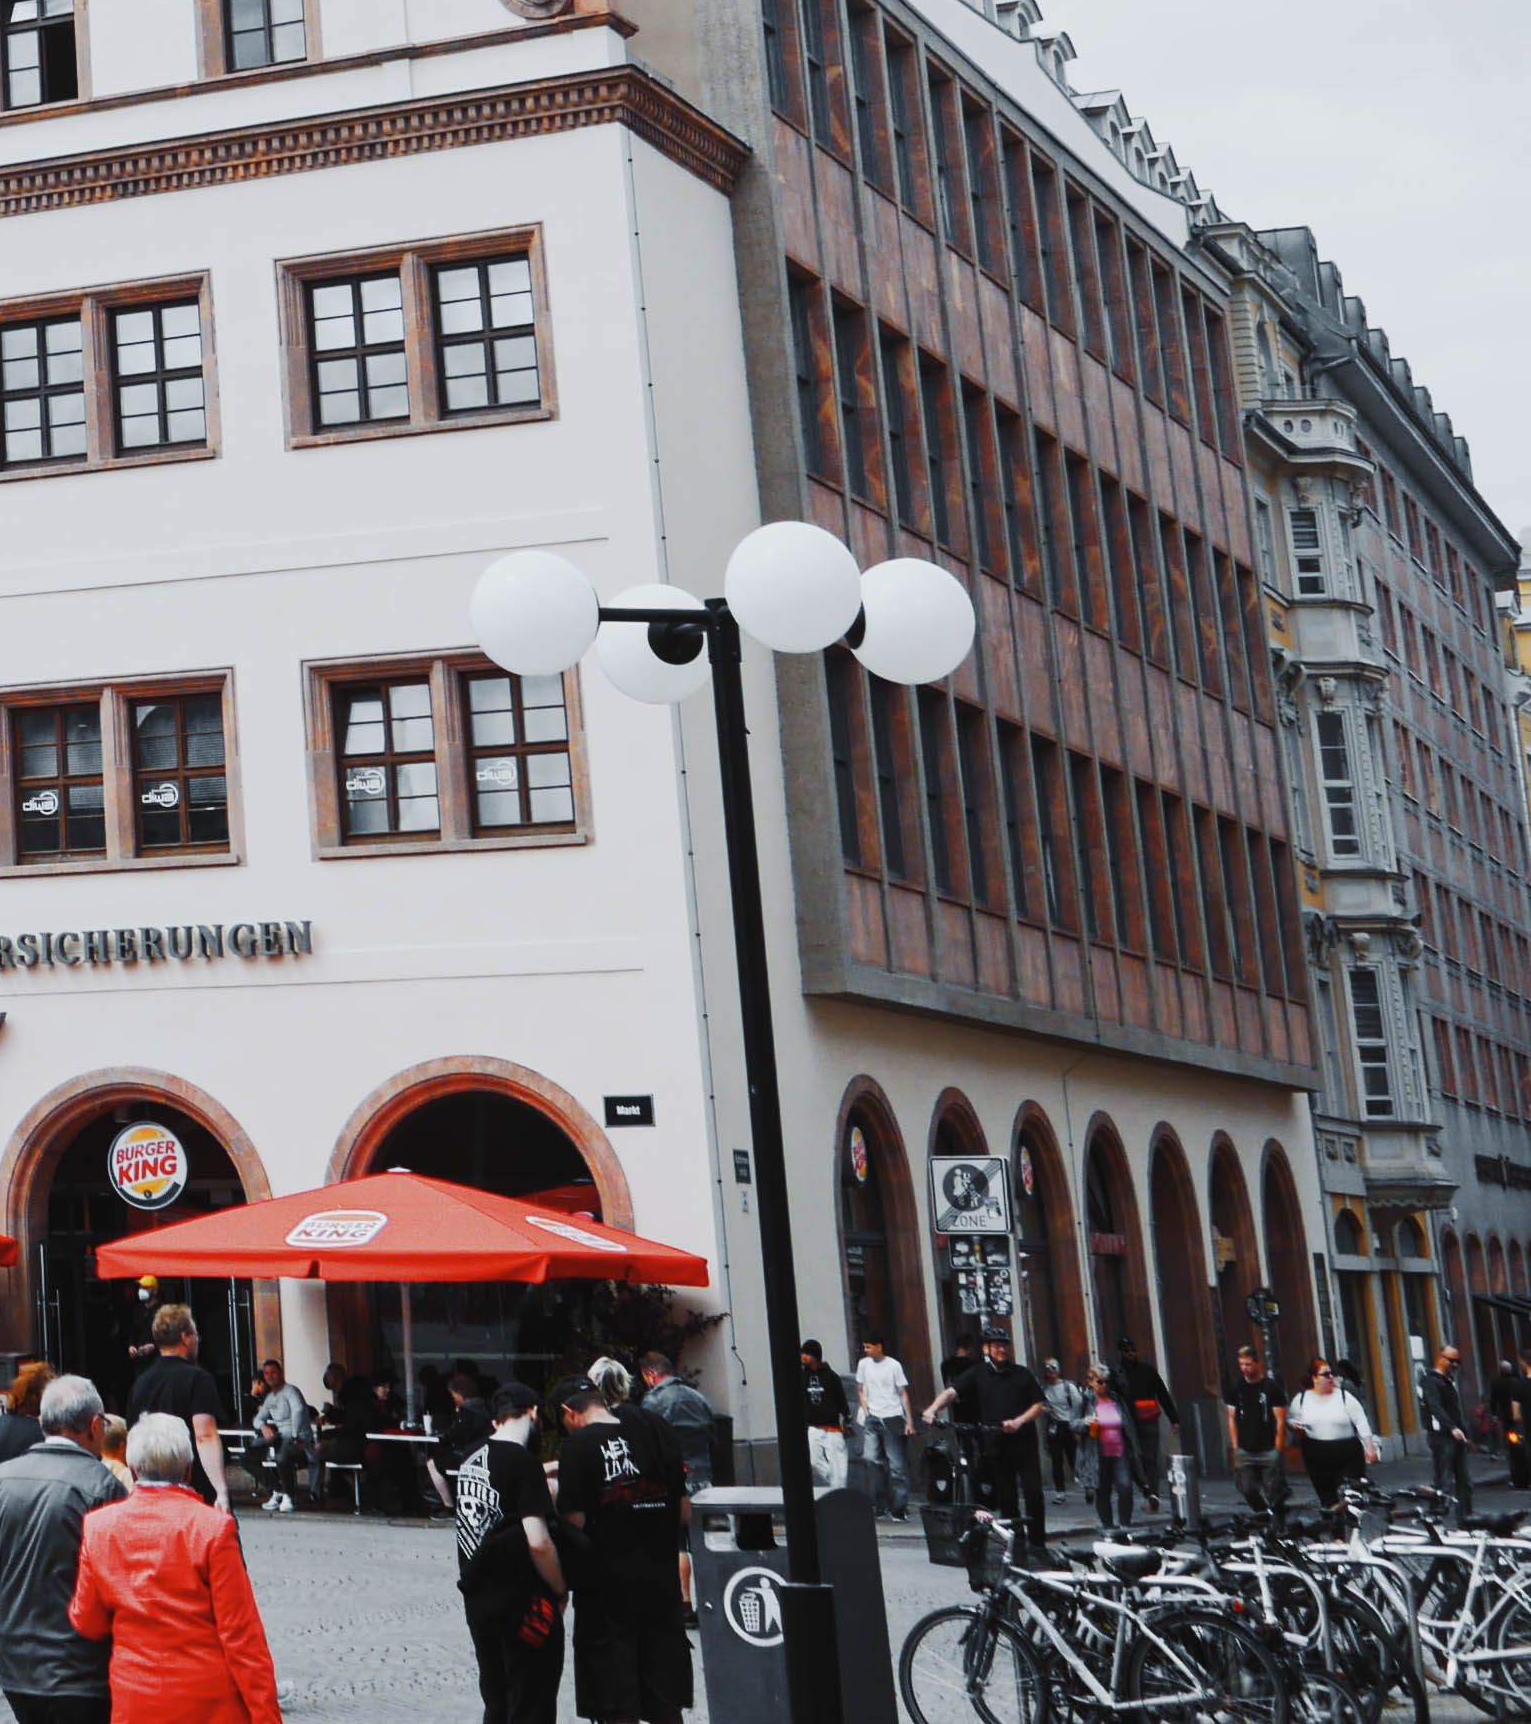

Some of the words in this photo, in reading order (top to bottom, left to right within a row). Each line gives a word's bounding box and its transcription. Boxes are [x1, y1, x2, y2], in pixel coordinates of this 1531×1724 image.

[615, 1105, 641, 1116] Markt
[116, 1140, 176, 1165] BURGER
[118, 1155, 178, 1186] KING
[296, 1229, 368, 1238] KING
